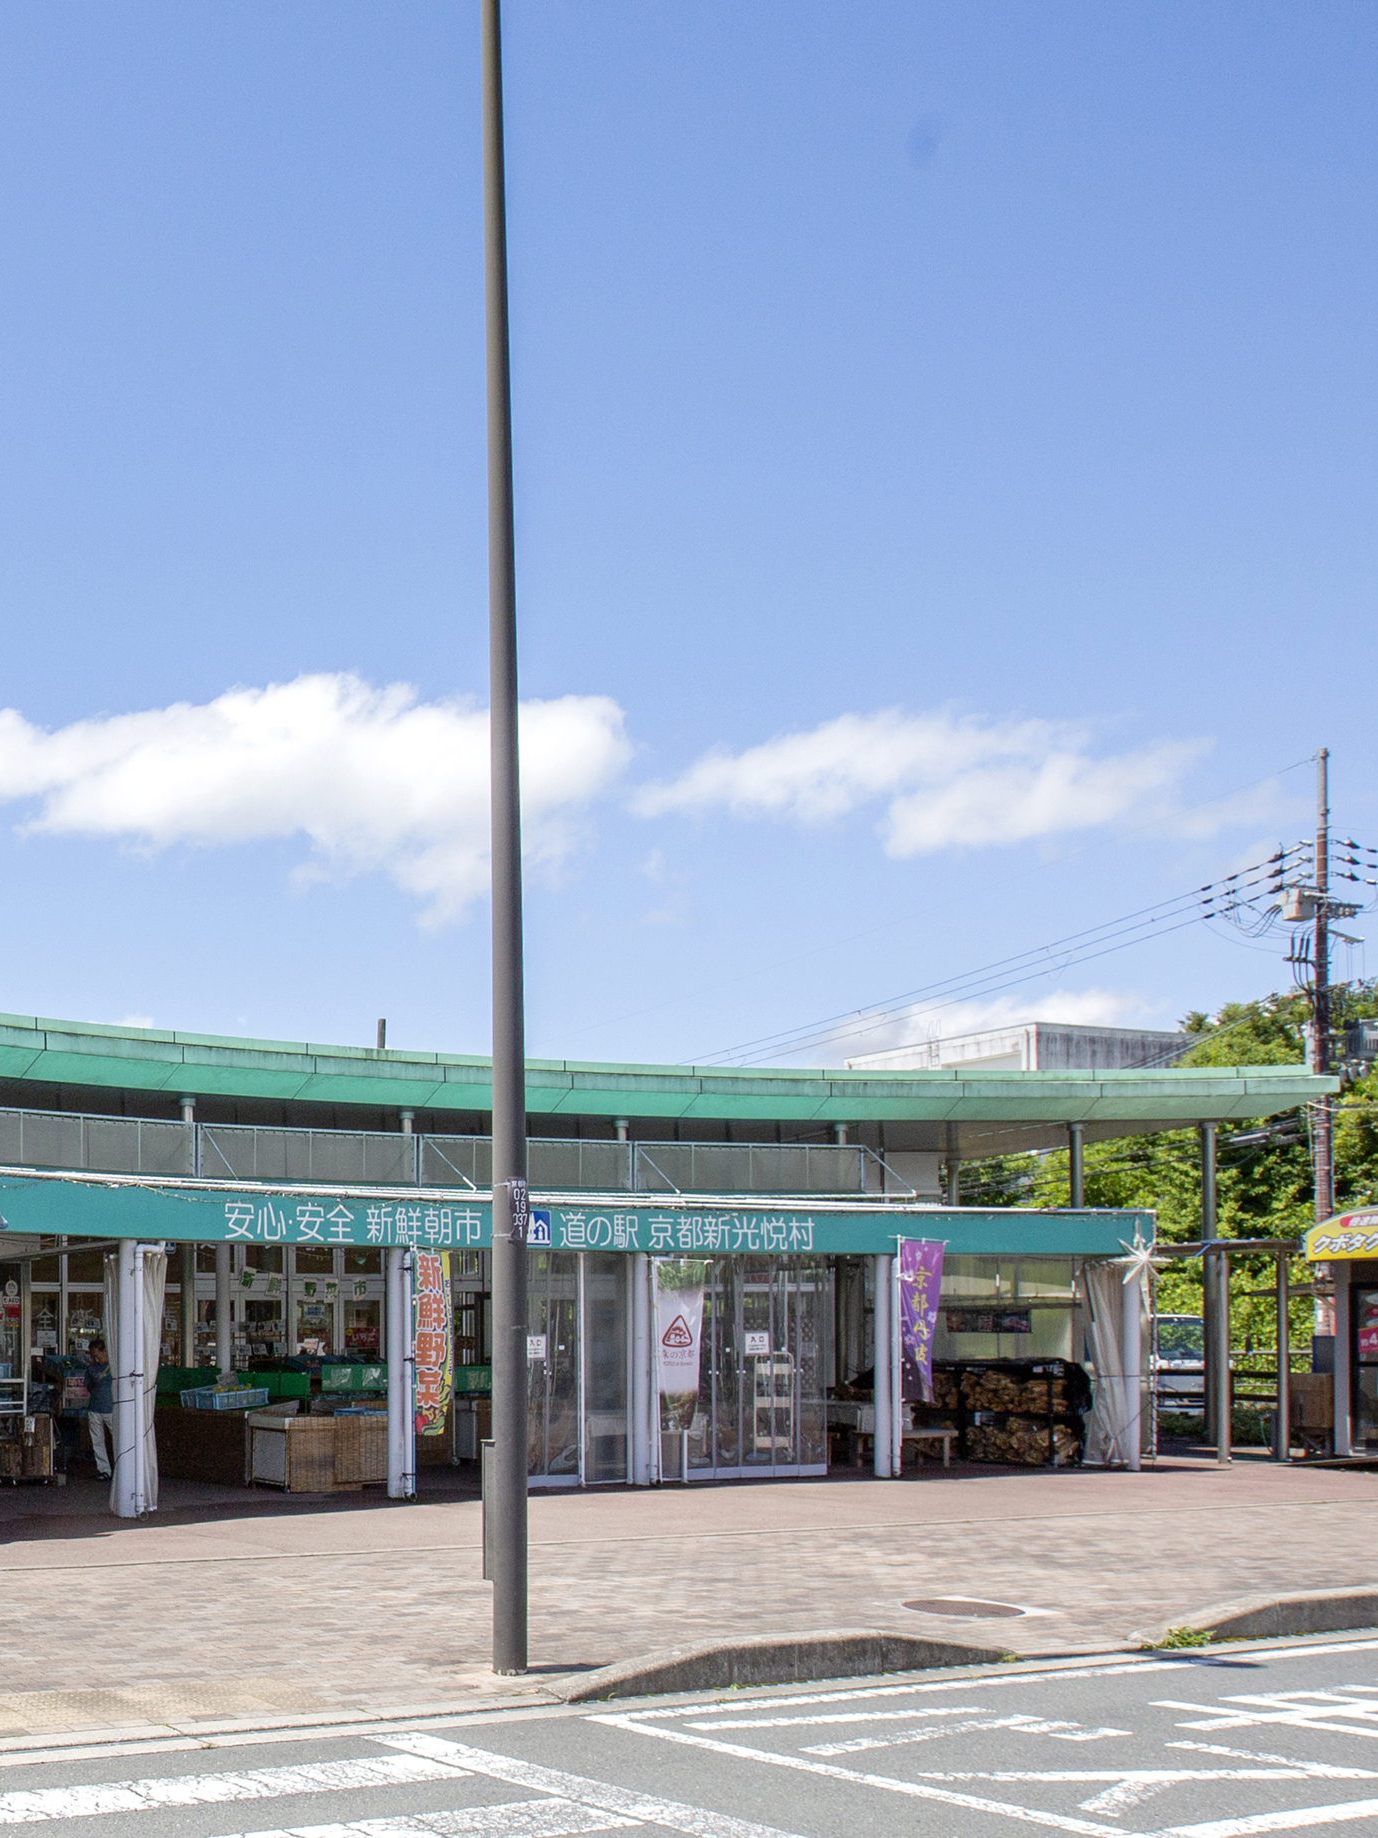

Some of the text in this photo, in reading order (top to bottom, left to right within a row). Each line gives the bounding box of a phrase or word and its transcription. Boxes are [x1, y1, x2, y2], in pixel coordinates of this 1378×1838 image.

[514, 1189, 526, 1200] 02
[515, 1201, 526, 1213] 19
[366, 1205, 482, 1245] 新鮮朝市
[519, 1226, 523, 1238] 1
[559, 1212, 815, 1250] 道の駅 京都新光悦村
[417, 1254, 445, 1407] 新鮮野菜
[911, 1266, 932, 1365] 京都丹波
